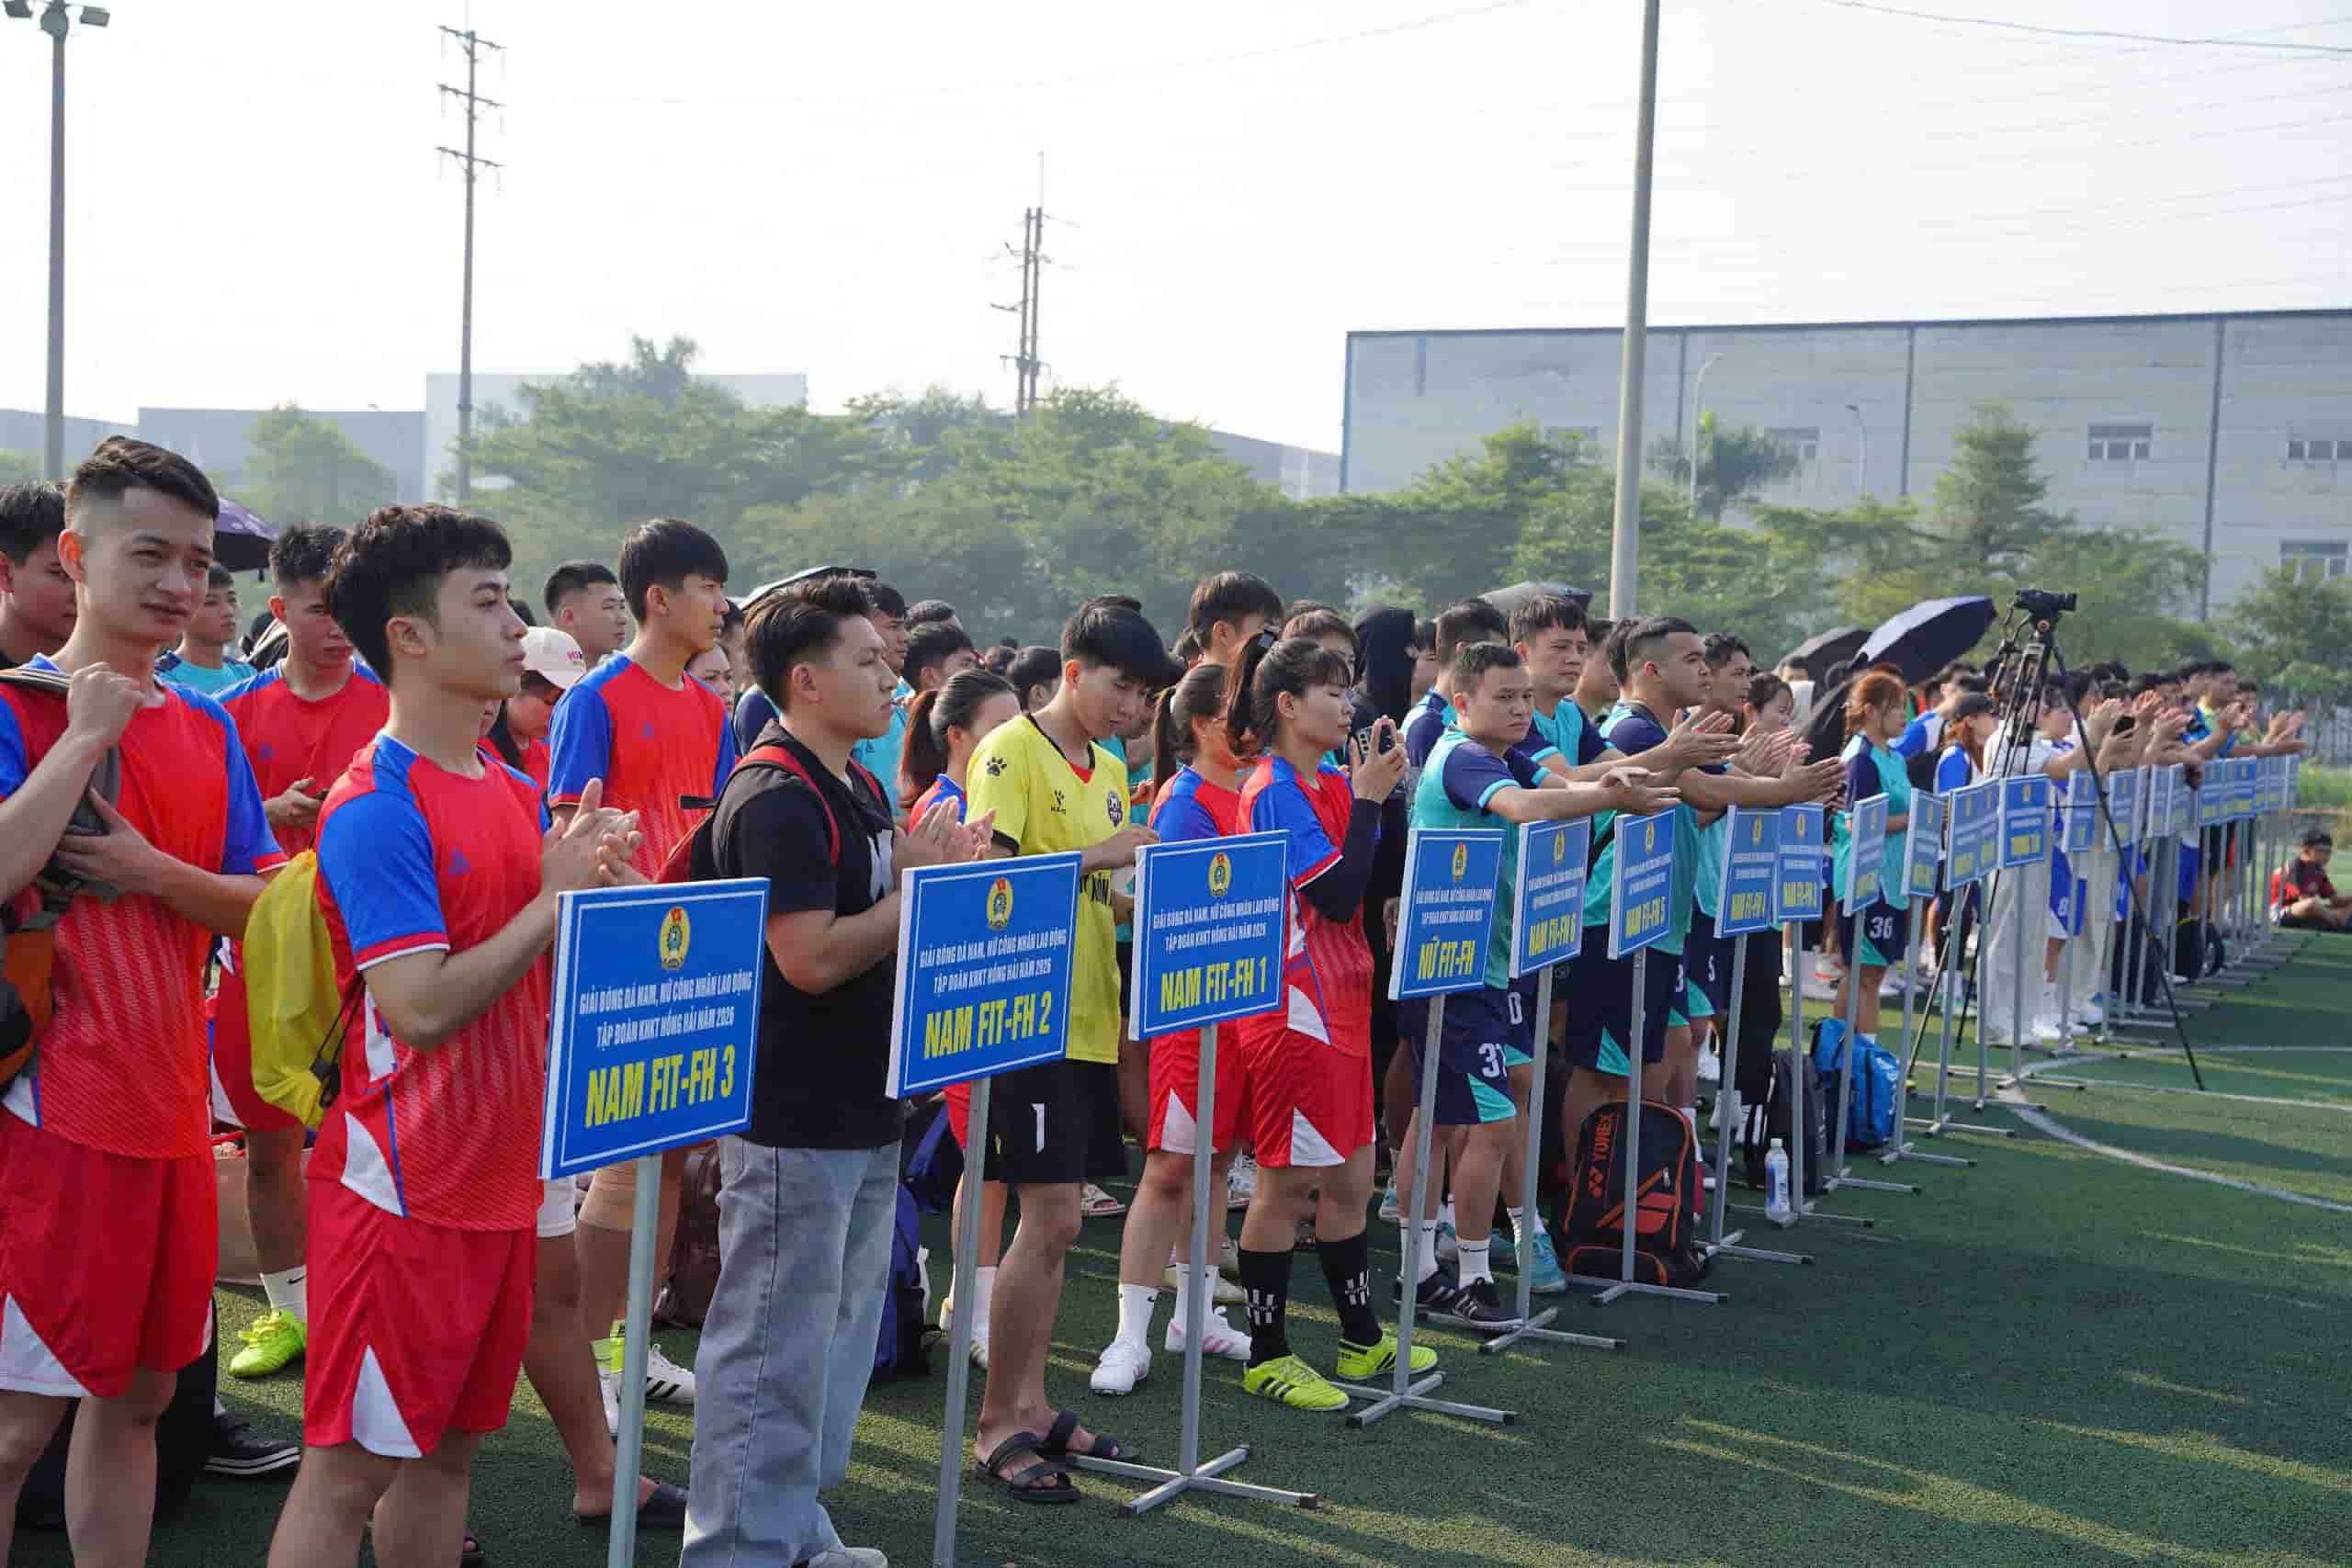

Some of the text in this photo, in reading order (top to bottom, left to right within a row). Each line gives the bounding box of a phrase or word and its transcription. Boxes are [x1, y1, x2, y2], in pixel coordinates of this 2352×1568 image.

[1870, 916, 1894, 939] 36
[1161, 955, 1267, 1013] NAM FIT-FH 1
[1418, 935, 1440, 980] NỮ
[924, 990, 1052, 1058] NAM FIT-FH 2
[585, 1044, 736, 1128] NAM FIT-FH 3
